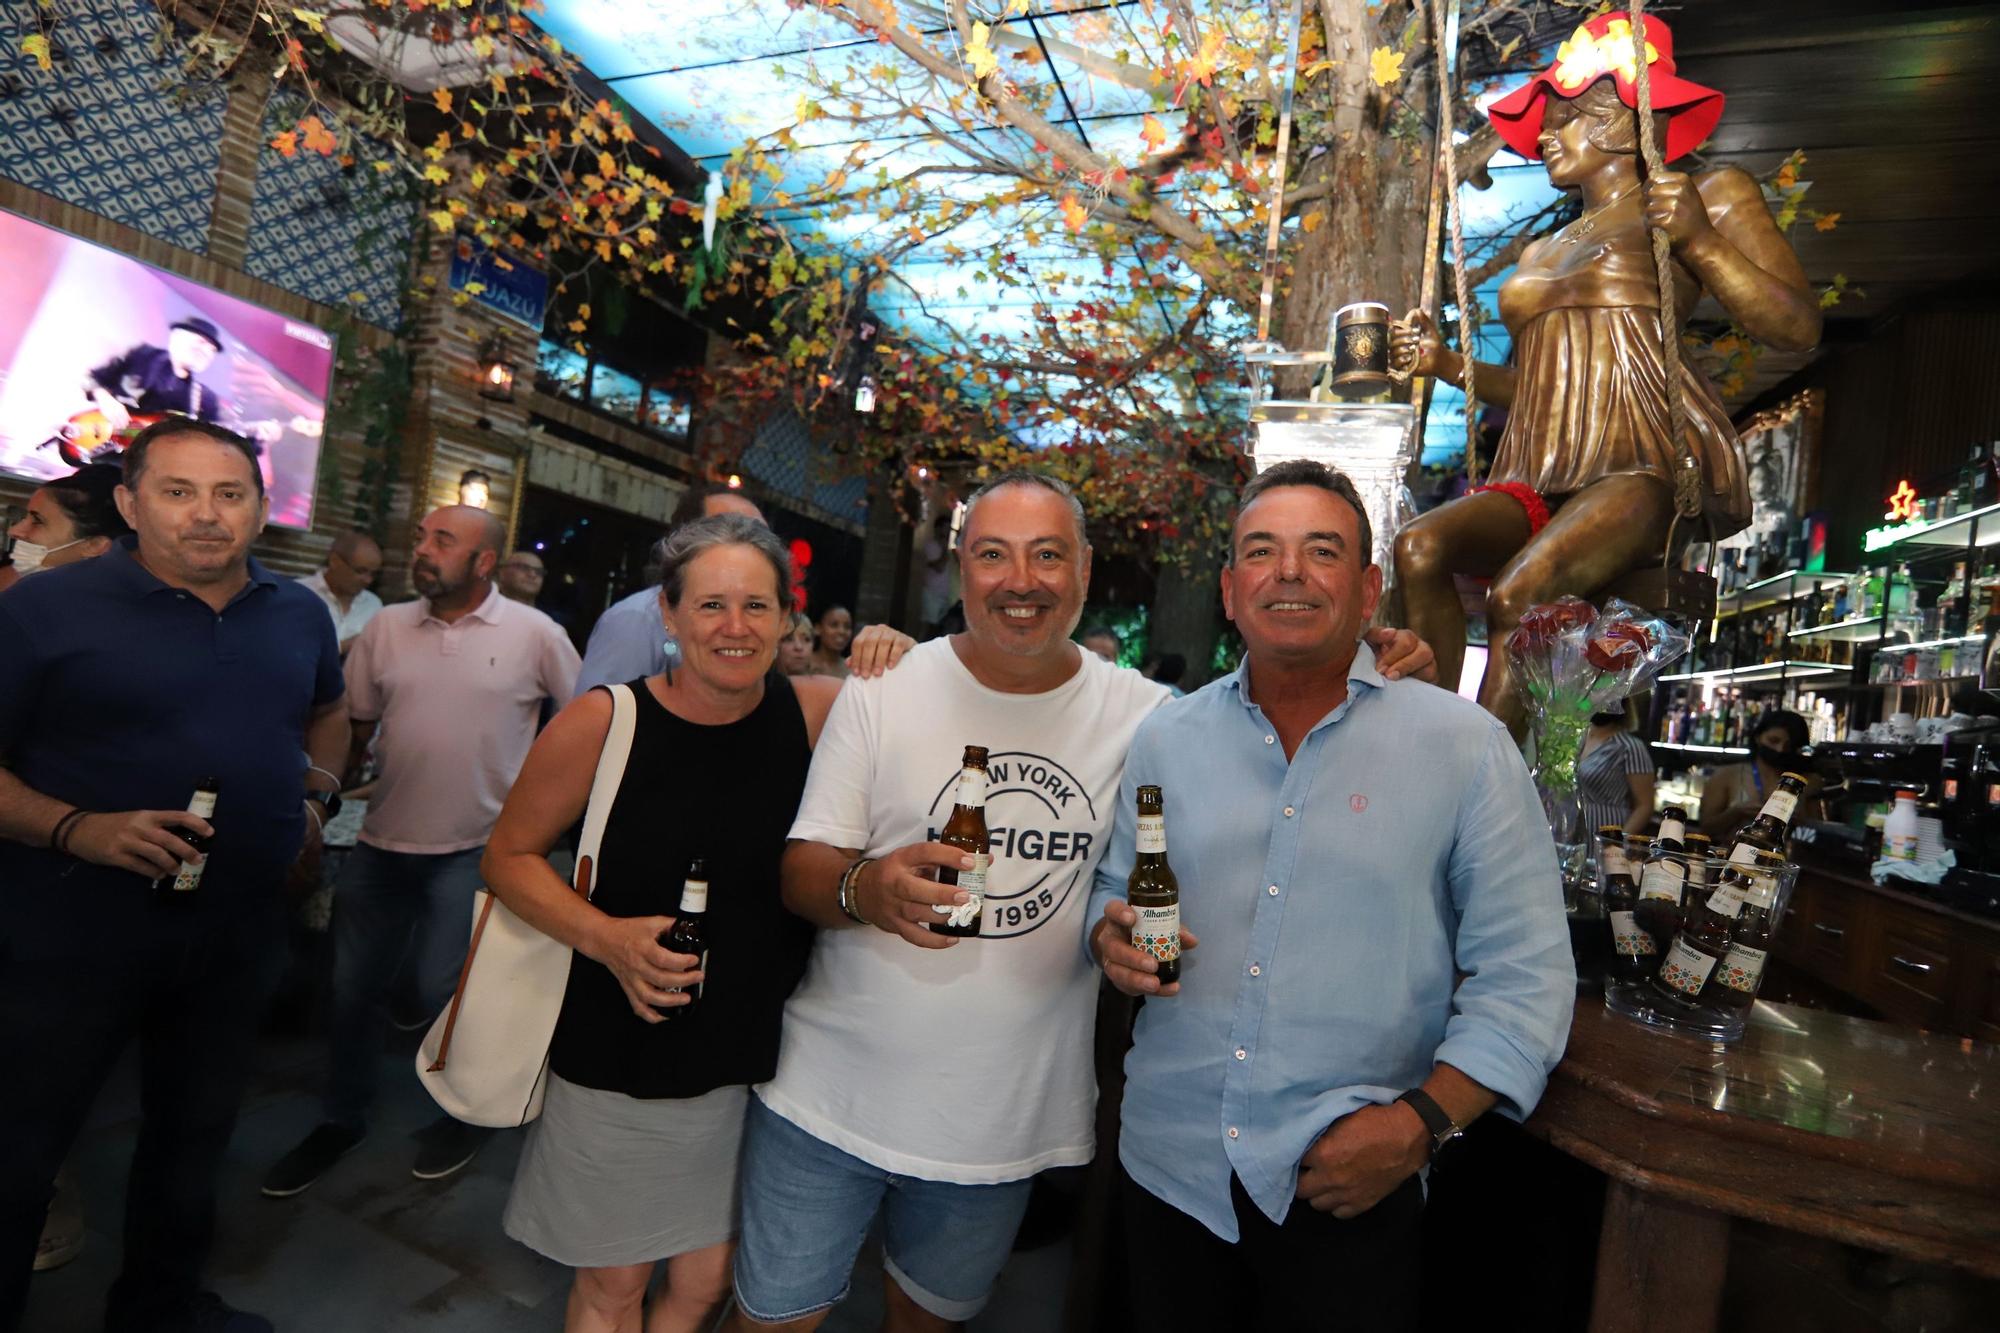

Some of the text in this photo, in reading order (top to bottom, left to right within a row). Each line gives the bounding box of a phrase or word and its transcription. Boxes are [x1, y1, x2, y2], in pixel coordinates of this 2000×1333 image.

[1017, 763, 1076, 808] YORK
[995, 889, 1053, 928] 1985
[1142, 909, 1177, 918] Alhambra
